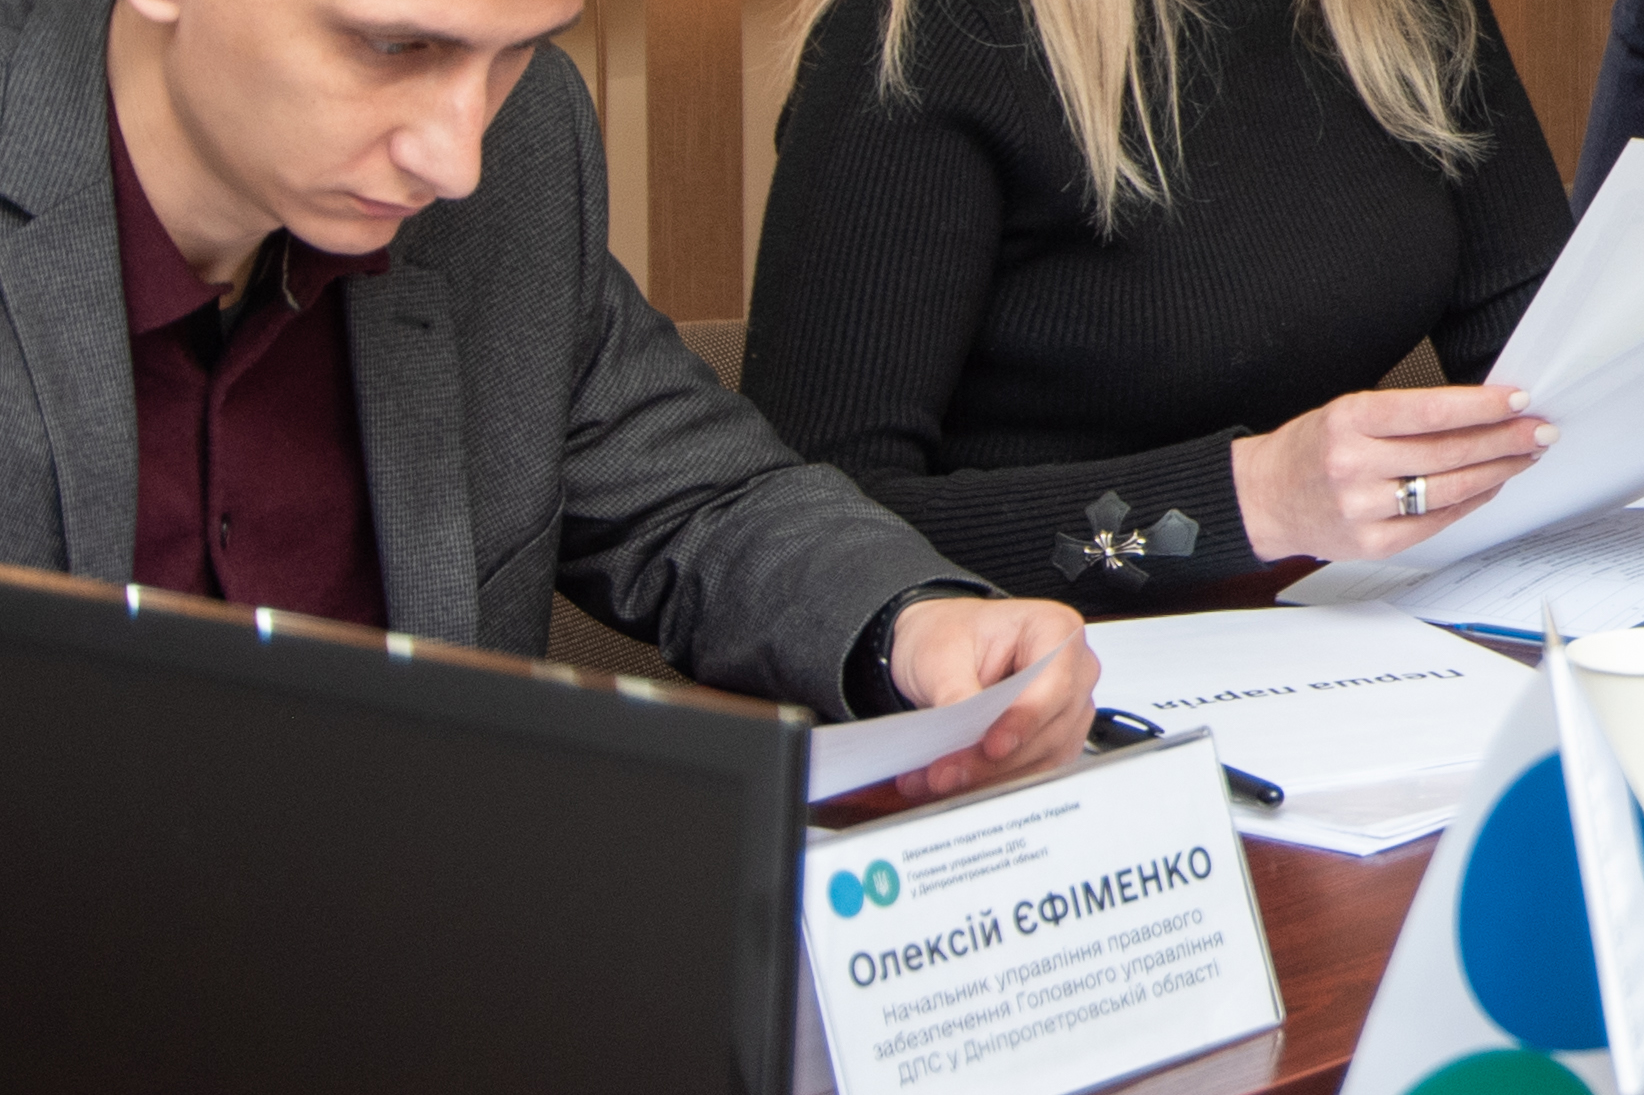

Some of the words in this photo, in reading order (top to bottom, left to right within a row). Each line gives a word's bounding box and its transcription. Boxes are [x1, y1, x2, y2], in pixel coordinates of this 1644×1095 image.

[1150, 685, 1298, 711] партія
[1307, 668, 1466, 691] Перша
[901, 839, 951, 863] Державна
[953, 823, 1004, 847] податкова
[1005, 811, 1042, 831] служба
[1043, 800, 1081, 820] України
[906, 862, 948, 883] Головне
[949, 845, 1004, 873] управління
[1005, 836, 1028, 856] ДПС
[918, 856, 1012, 896] Дніпропетровській
[1012, 846, 1049, 867] області
[848, 906, 1004, 988] Олексій
[1012, 844, 1213, 936] ЄФІМЕНКО
[872, 998, 1013, 1062] забезпечення
[1015, 965, 1118, 1013] Головного
[1120, 929, 1225, 984] управління
[881, 975, 992, 1028] Начальник
[994, 939, 1103, 995] управління
[1106, 907, 1204, 953] правового
[897, 1051, 943, 1088] ДПС
[946, 1047, 959, 1073] у
[963, 981, 1148, 1065] Дніпропетровській
[1151, 955, 1221, 999] області
